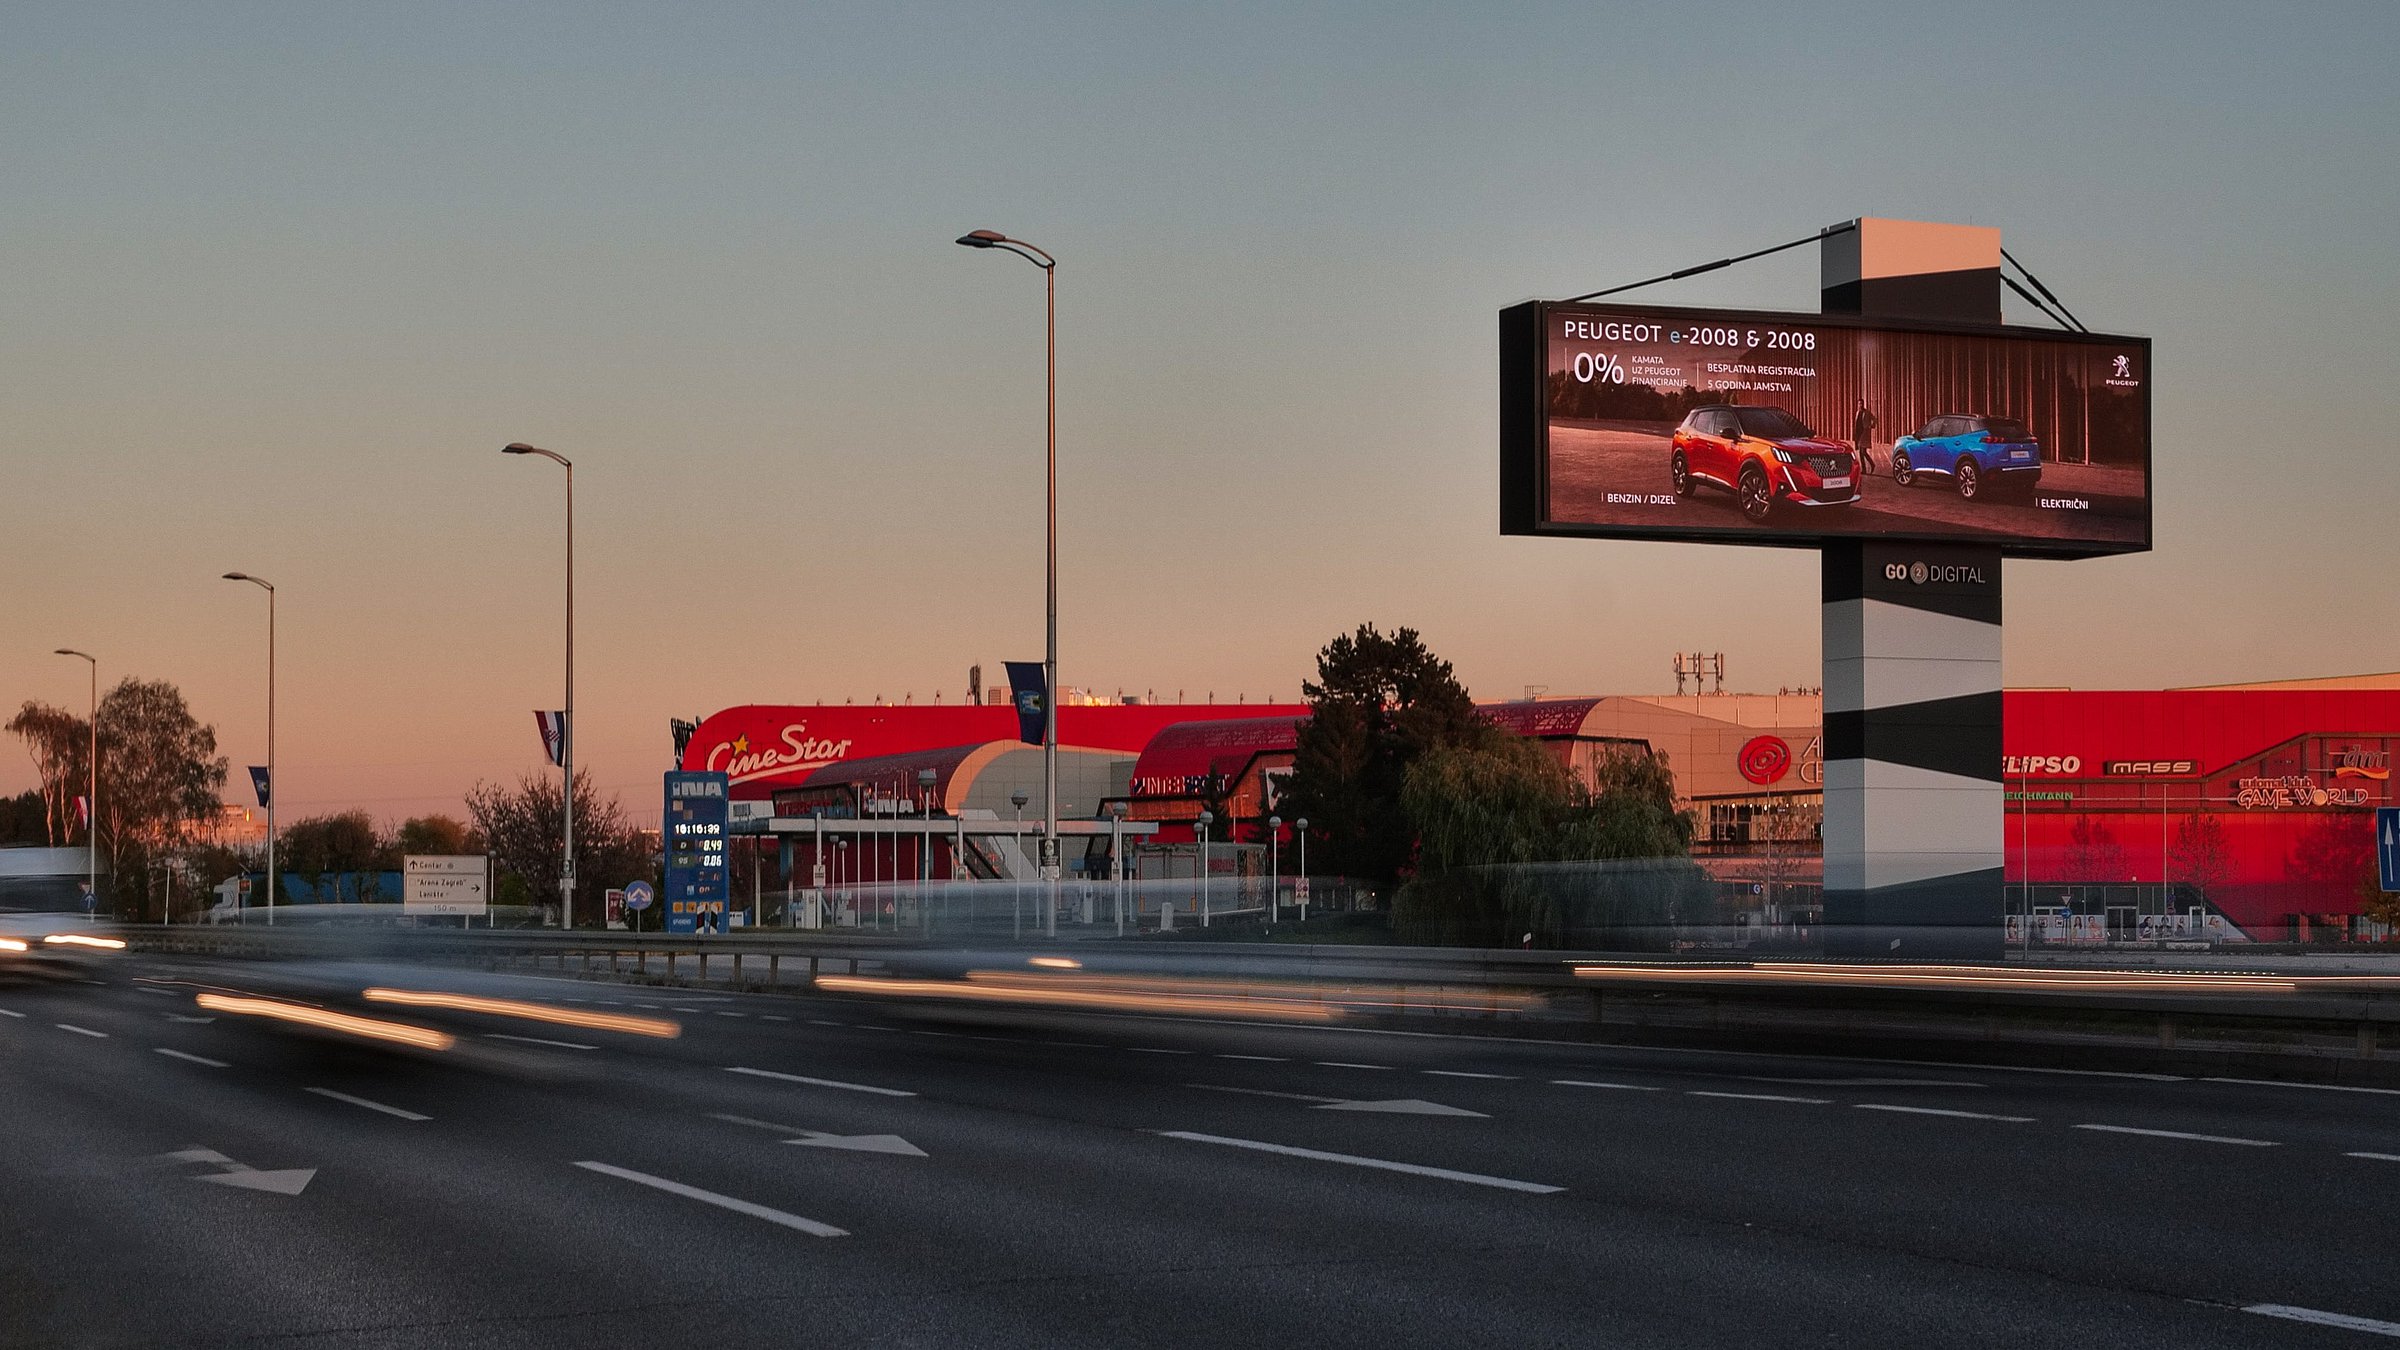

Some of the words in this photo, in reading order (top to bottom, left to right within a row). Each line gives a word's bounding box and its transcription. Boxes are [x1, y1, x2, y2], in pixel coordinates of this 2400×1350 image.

[1565, 320, 1662, 342] PEUGEOT
[1670, 326, 1739, 346] e-2008
[1746, 329, 1760, 348] &
[1767, 331, 1816, 351] 2008
[1631, 355, 1664, 365] KAMATA
[1574, 352, 1625, 385] 0%
[1631, 366, 1643, 375] UZ
[1644, 367, 1681, 376] PEUGEOT
[1707, 363, 1756, 374] BESPLATNA
[1758, 365, 1817, 377] REGISTRACIJA
[1631, 377, 1688, 387] FINANCIRANJE
[1707, 380, 1713, 389] 5
[1715, 380, 1752, 390] GODINA
[1753, 381, 1792, 392] JAMSTVA
[2105, 379, 2139, 387] PEUGEOT
[1607, 493, 1642, 504] BENZIN
[1650, 494, 1676, 505] DIZEL
[2041, 498, 2089, 510] ELEKTRIČNI
[1885, 563, 1907, 580] GO
[1930, 565, 1986, 583] DIGITAL
[707, 723, 852, 777] CineStar
[2112, 762, 2192, 773] MASS
[2237, 788, 2294, 810] GAME
[2295, 785, 2369, 807] WORLD
